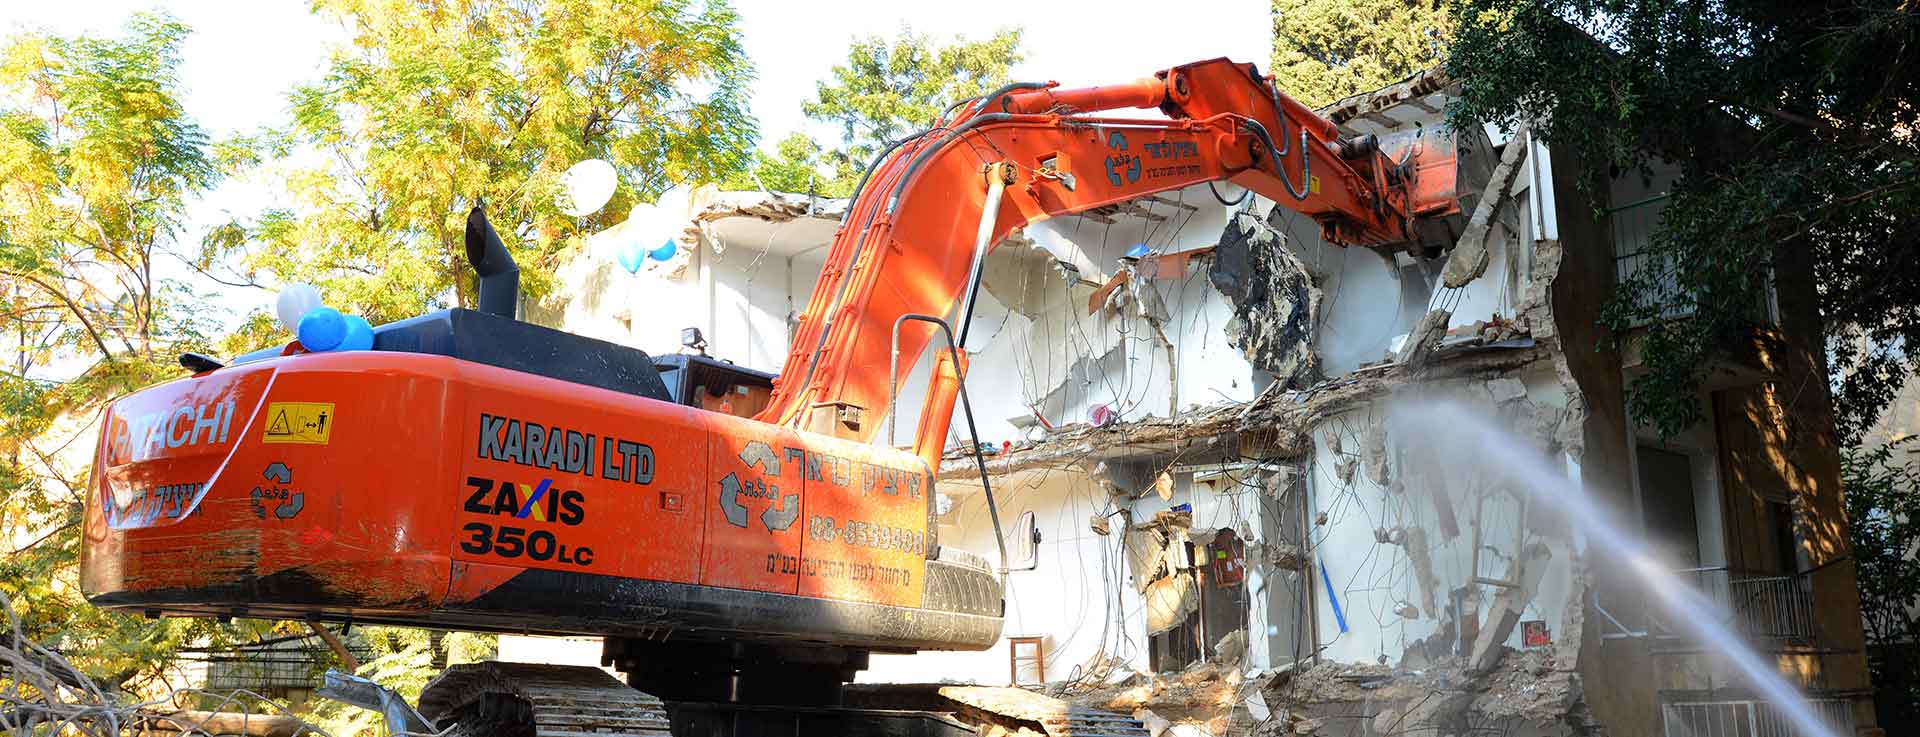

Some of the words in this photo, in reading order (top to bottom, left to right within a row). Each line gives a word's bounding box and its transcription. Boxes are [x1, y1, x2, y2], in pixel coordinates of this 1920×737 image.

[478, 413, 596, 476] KARADI
[602, 437, 656, 485] LTD
[464, 476, 585, 526] ZAXIS
[460, 522, 594, 565] 350LC
